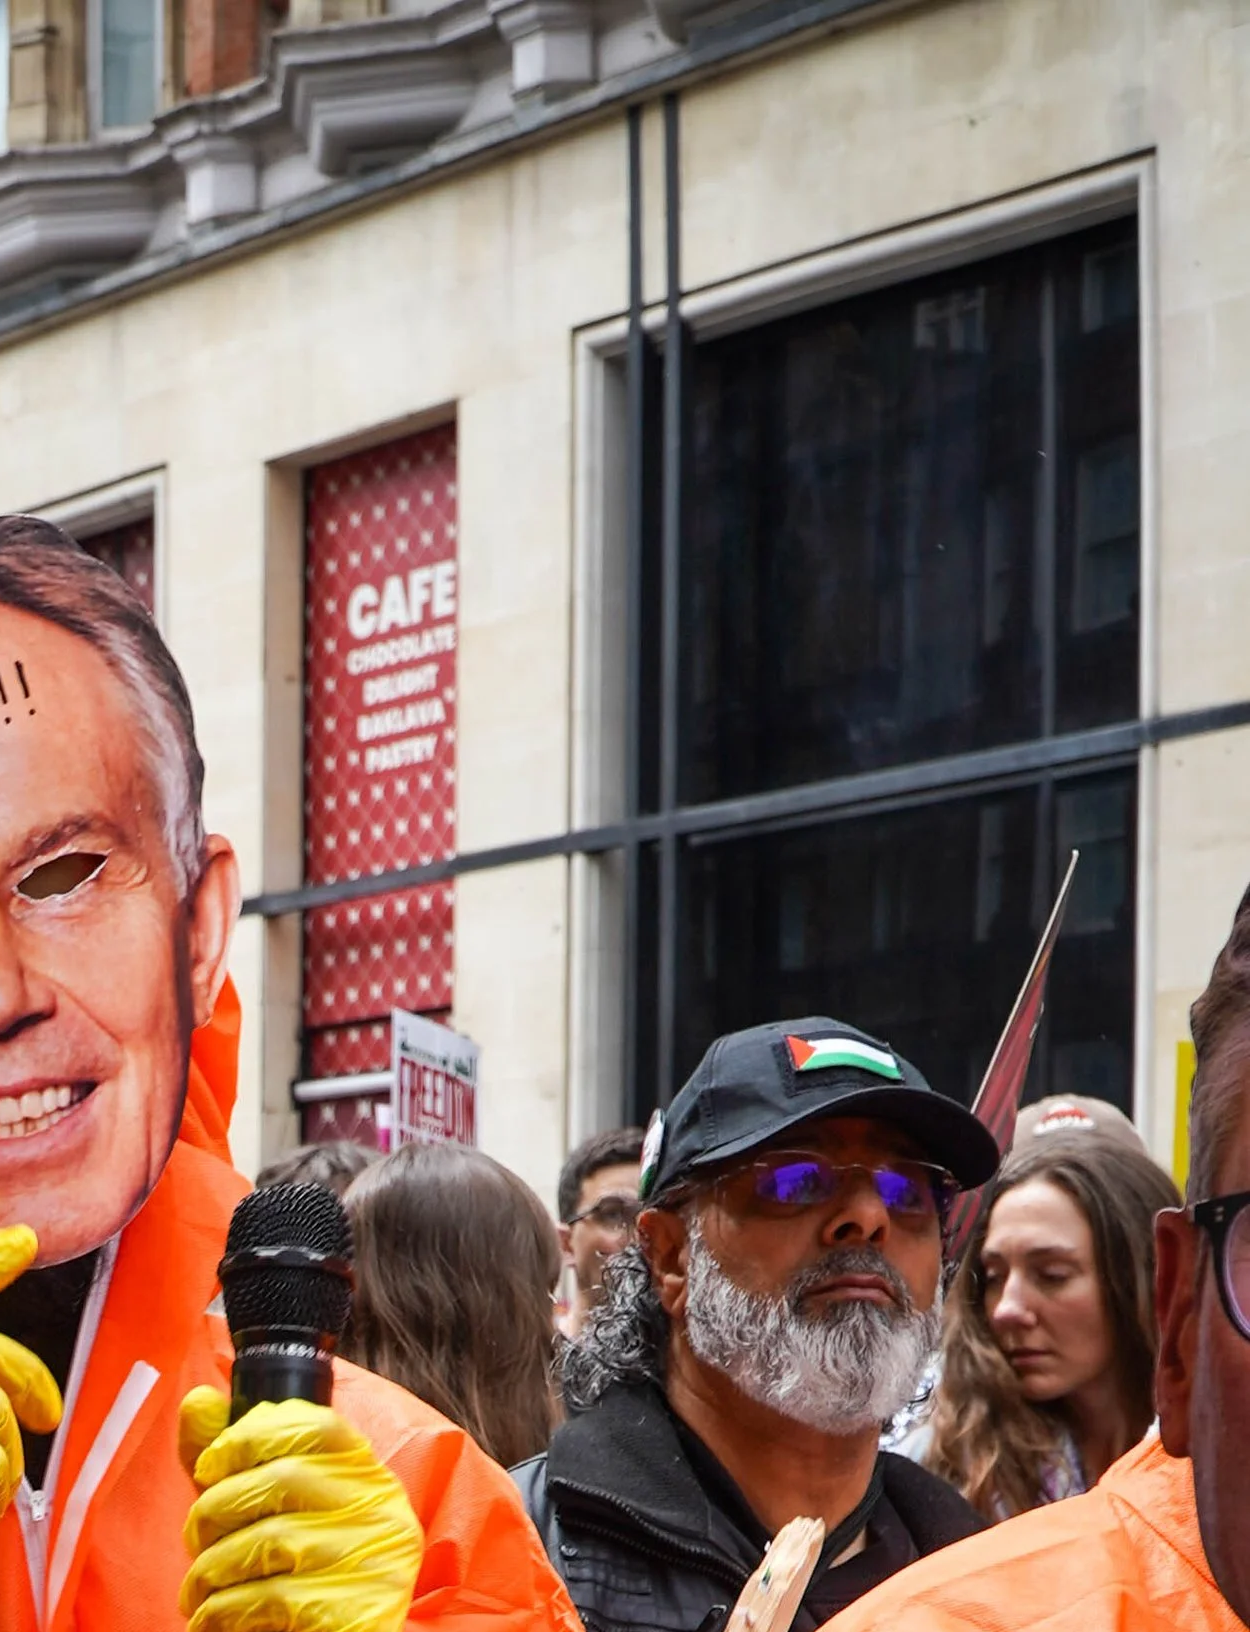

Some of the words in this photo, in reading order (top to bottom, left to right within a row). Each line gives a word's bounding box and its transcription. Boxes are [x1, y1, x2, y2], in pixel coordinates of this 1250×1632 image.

[347, 558, 456, 639] CAFE
[347, 622, 456, 676] CHOCOLATE
[363, 662, 439, 706] DELIGHT
[365, 732, 438, 774] PASTRY
